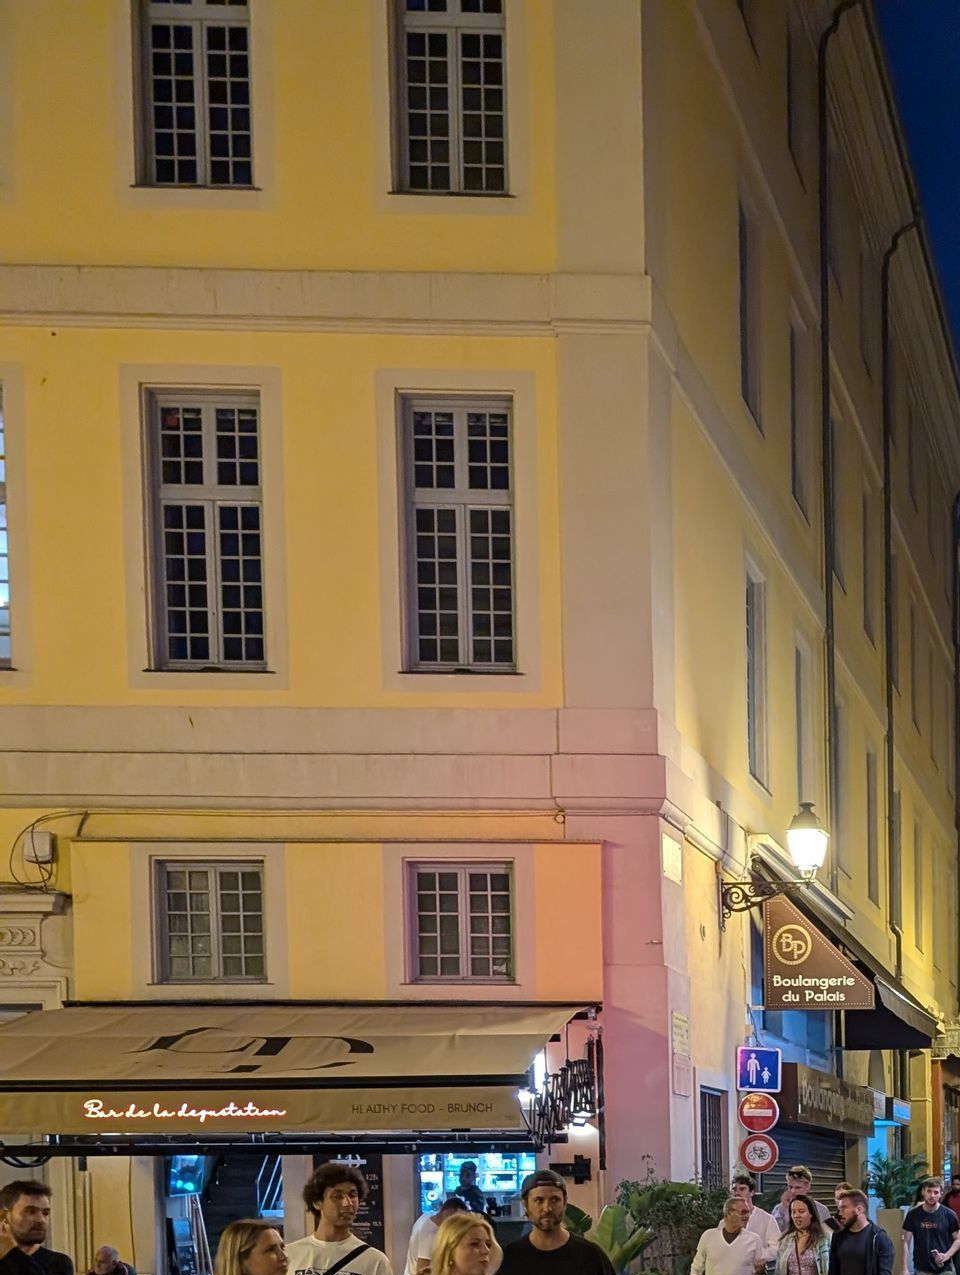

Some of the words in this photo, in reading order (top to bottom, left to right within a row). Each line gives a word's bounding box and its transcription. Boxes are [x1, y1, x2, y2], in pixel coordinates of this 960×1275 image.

[780, 933, 807, 960] BP
[773, 975, 856, 990] Boulangerie
[782, 990, 800, 1002] du
[805, 990, 846, 1002] Palais
[83, 1099, 124, 1119] Bar
[125, 1103, 152, 1118] de
[153, 1103, 176, 1118] la
[177, 1101, 287, 1122] degustation
[352, 1103, 398, 1114] HEALTHY
[402, 1103, 435, 1113] FOOD
[448, 1102, 493, 1113] BRUNCH
